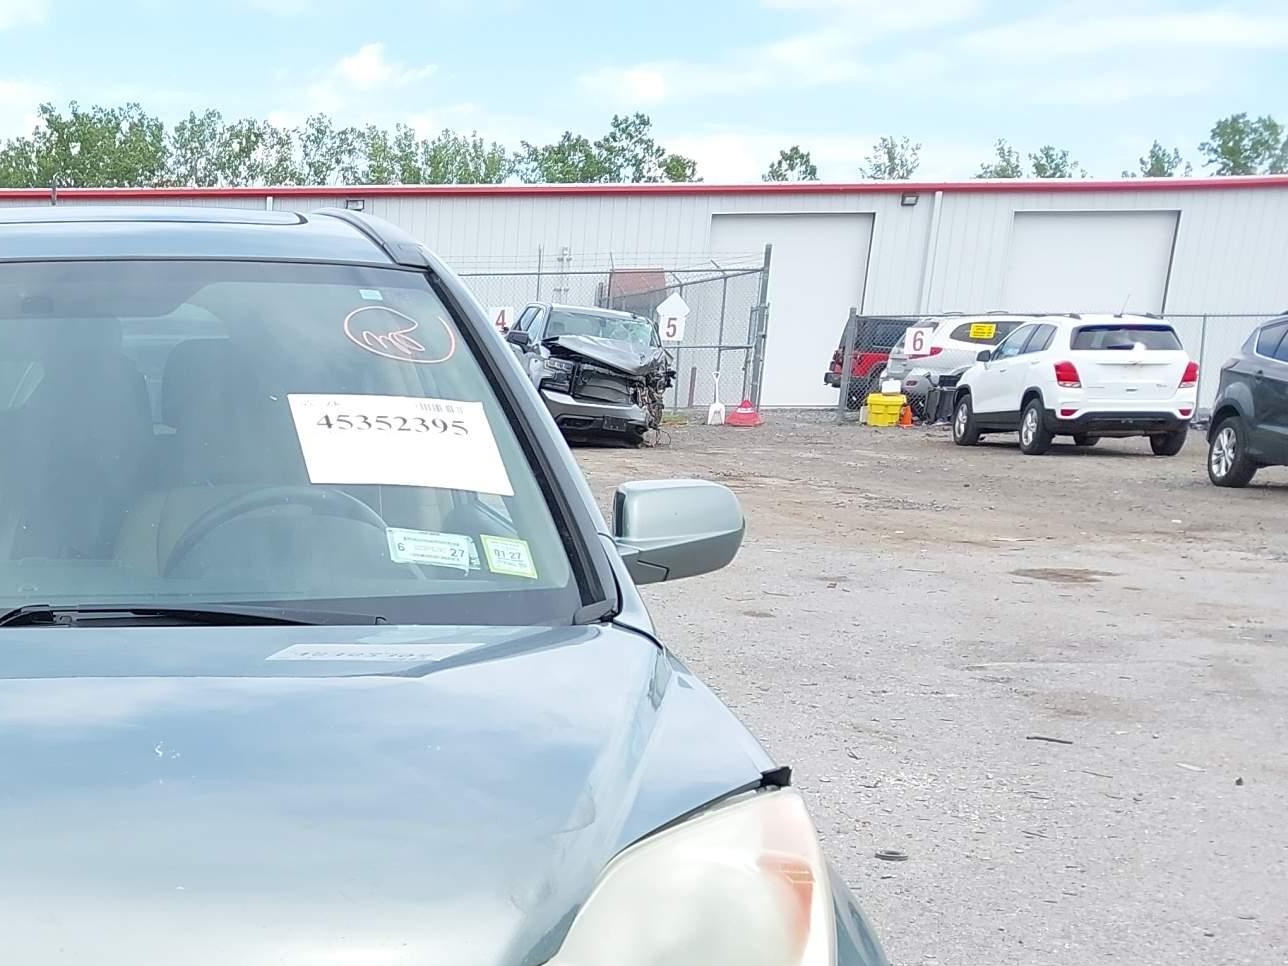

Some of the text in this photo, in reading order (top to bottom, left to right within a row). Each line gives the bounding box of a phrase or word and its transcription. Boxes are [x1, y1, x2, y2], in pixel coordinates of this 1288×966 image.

[495, 309, 507, 332] 4
[665, 317, 678, 338] 5
[912, 330, 924, 352] 6
[316, 413, 470, 437] 45352395
